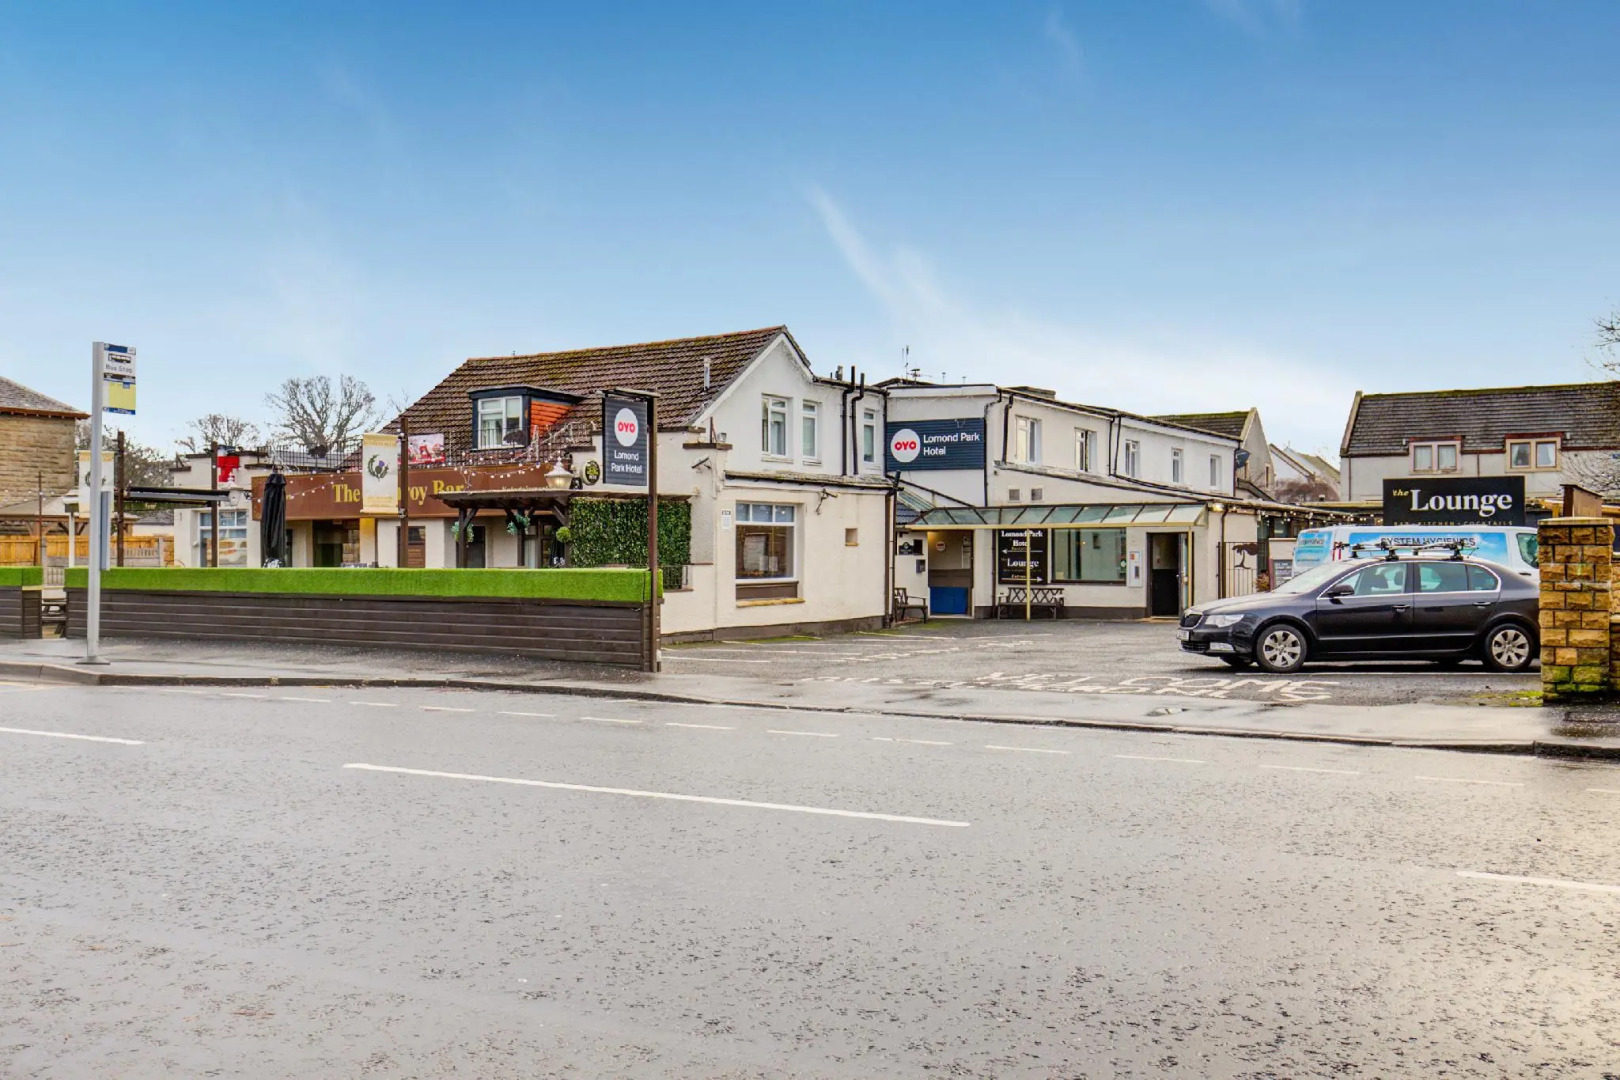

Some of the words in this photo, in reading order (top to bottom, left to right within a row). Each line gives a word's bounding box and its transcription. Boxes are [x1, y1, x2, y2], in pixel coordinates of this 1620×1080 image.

[105, 363, 117, 371] Bus
[118, 365, 133, 374] Stop
[618, 422, 636, 433] OYO
[923, 432, 959, 443] Lomond
[960, 432, 980, 442] Park
[894, 440, 917, 451] OYO
[923, 446, 946, 456] Hotel
[614, 450, 638, 461] Lomond
[611, 463, 625, 472] Park
[625, 464, 643, 474] Hotel
[332, 483, 360, 503] The
[1392, 489, 1410, 497] the
[1410, 489, 1513, 518] Lounge
